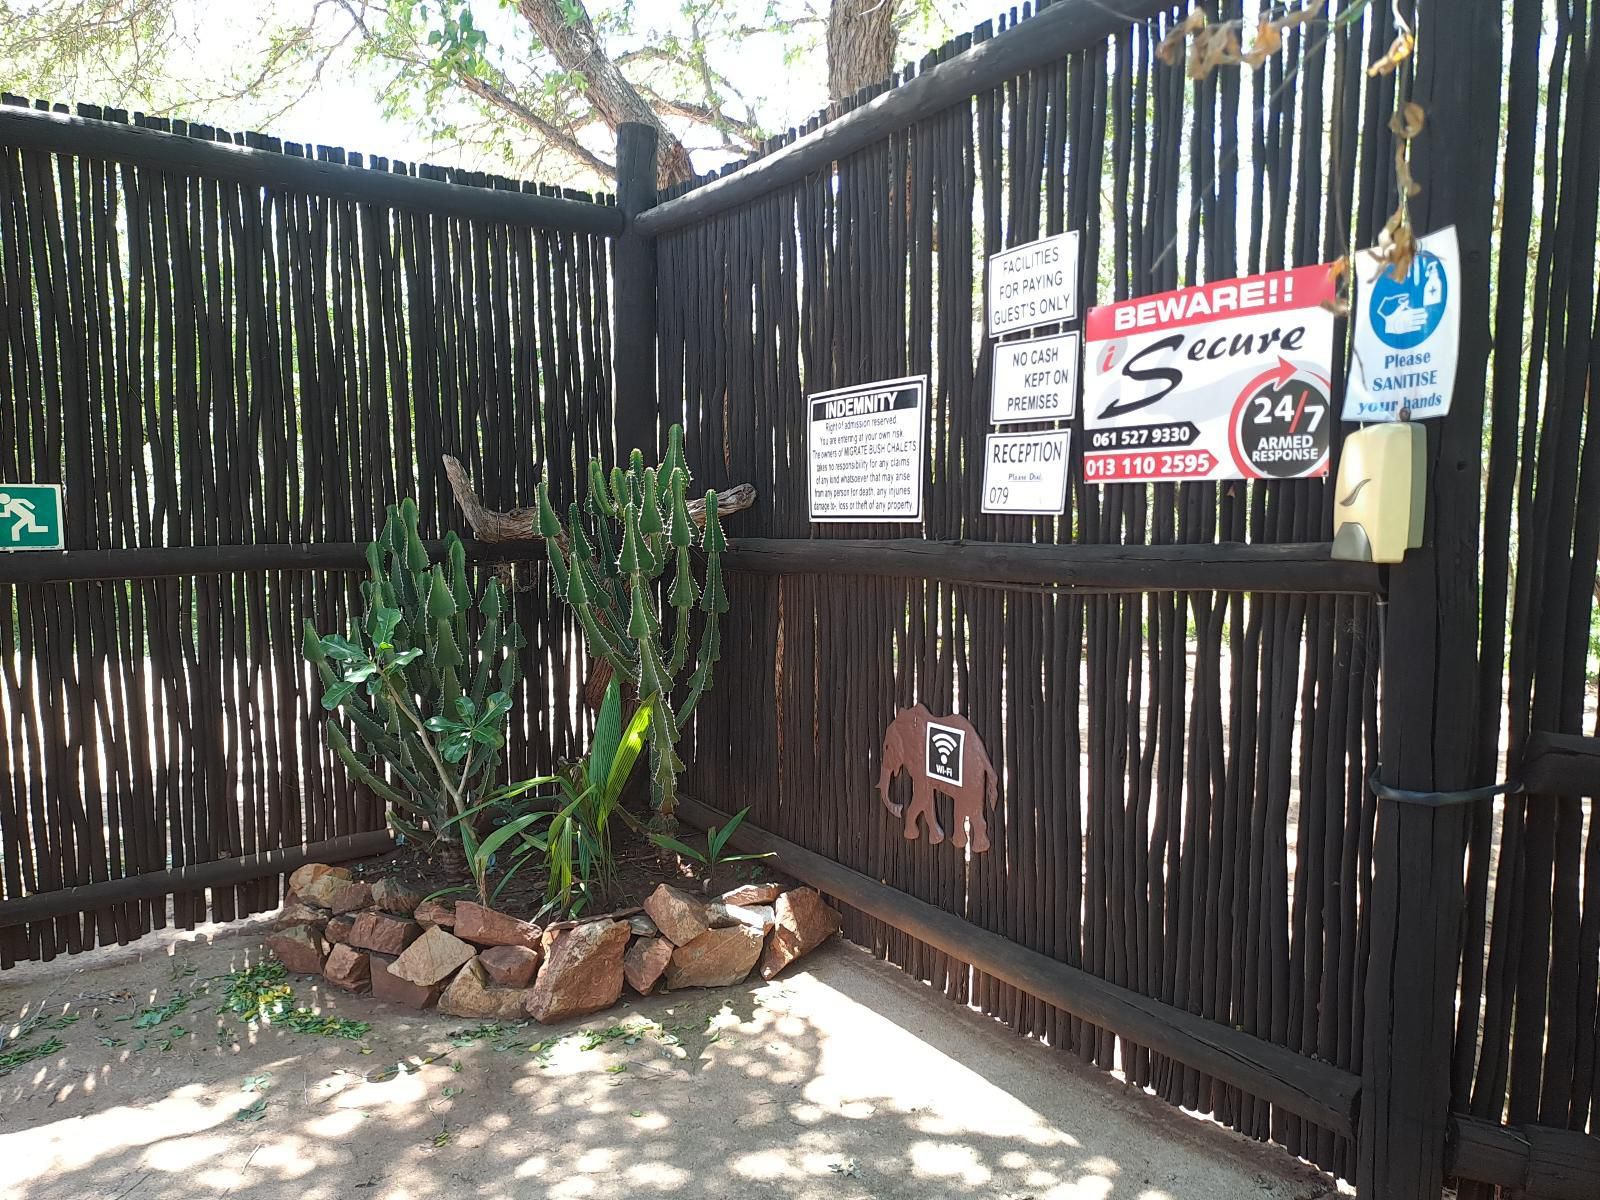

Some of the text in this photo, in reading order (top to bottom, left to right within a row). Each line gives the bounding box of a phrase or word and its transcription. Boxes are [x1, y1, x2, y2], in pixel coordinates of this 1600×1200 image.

[1003, 246, 1059, 273] FACILITIES
[1000, 270, 1063, 300] FOR PAYING
[994, 295, 1071, 325] GUEST'S ONLY
[1114, 276, 1294, 330] BEWARE!!
[1012, 347, 1058, 367] NO CASH
[1385, 352, 1431, 369] Please
[1024, 370, 1068, 388] KEPT ON
[1372, 370, 1438, 391] SANITISE
[826, 392, 897, 419] INDEMNITY
[1007, 393, 1058, 412] PREMISES
[1253, 390, 1325, 433] 24/7
[1358, 393, 1442, 414] your hands
[826, 423, 837, 434] Right
[845, 419, 870, 429] admission
[820, 437, 828, 445] You
[838, 434, 857, 444] entering
[859, 433, 863, 441] at
[865, 433, 876, 443] your
[1093, 427, 1190, 446] 061 527 9330
[1258, 435, 1313, 450] ARMED
[845, 445, 867, 456] MIGRATE
[869, 445, 885, 454] BUSH
[887, 441, 916, 453] CHALETS
[993, 441, 1062, 463] RECEPTION
[1252, 448, 1318, 462] RESPONSE
[836, 461, 868, 470] responsibility
[879, 460, 888, 470] any
[891, 458, 909, 466] claims
[1086, 454, 1210, 476] 013 110 2595
[830, 475, 839, 484] kind
[841, 475, 868, 483] whatsoever
[870, 472, 880, 481] that
[882, 474, 893, 484] may
[896, 472, 910, 480] arise
[815, 489, 824, 497] from
[834, 489, 849, 498] person
[877, 488, 886, 498] any
[990, 487, 1009, 504] 079
[814, 503, 829, 512] damage
[856, 500, 867, 509] theft
[869, 500, 874, 509] of
[876, 502, 885, 512] any
